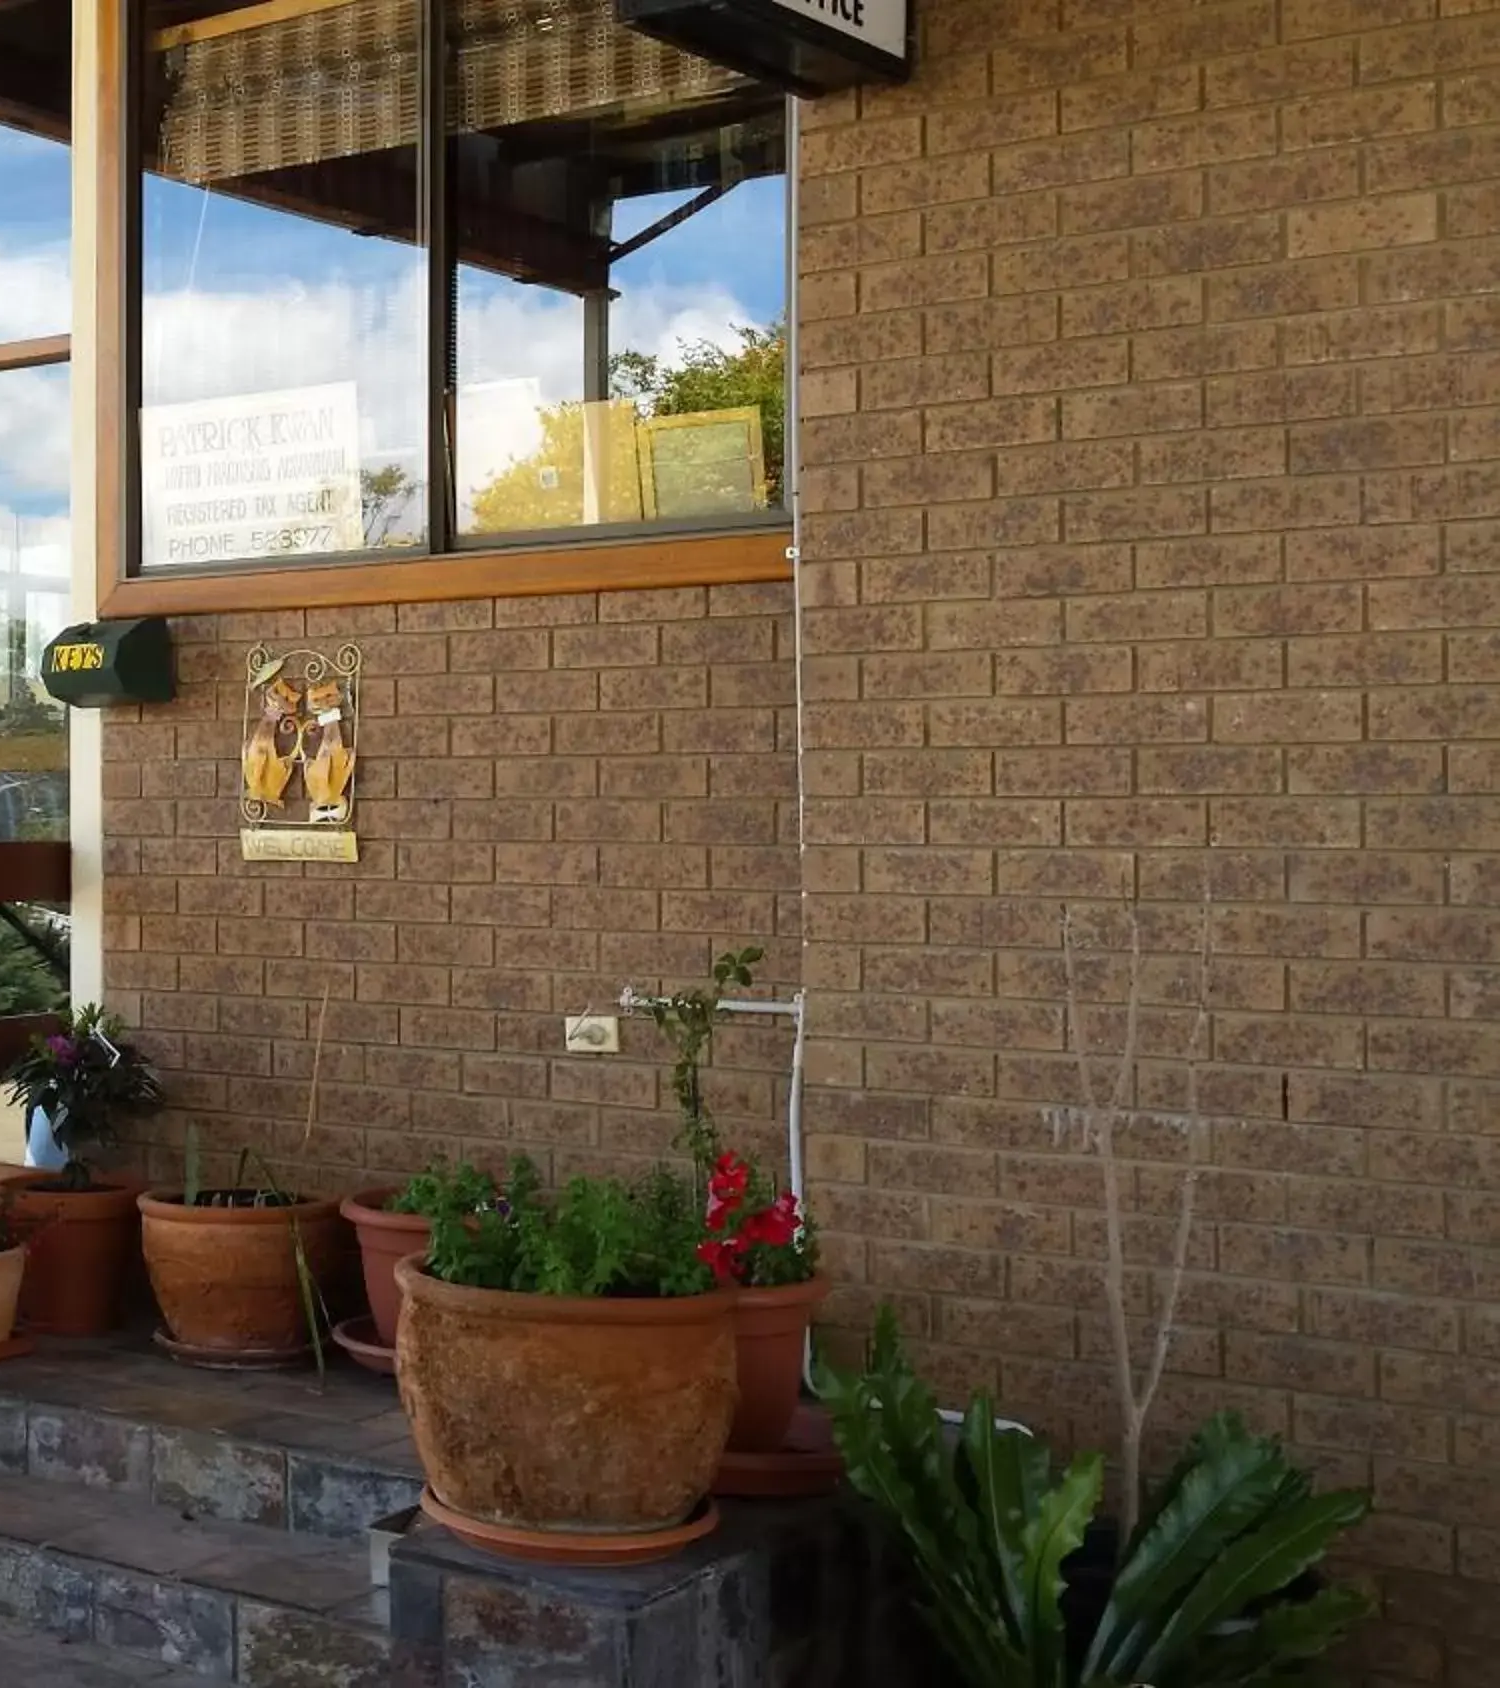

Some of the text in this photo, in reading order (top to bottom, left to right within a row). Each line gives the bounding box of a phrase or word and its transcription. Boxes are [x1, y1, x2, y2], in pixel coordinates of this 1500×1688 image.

[159, 415, 262, 458] PATRICK
[287, 488, 332, 514] AGENT
[169, 532, 235, 558] PHONE
[52, 643, 102, 672] KEYS
[245, 835, 350, 859] WELCOME
